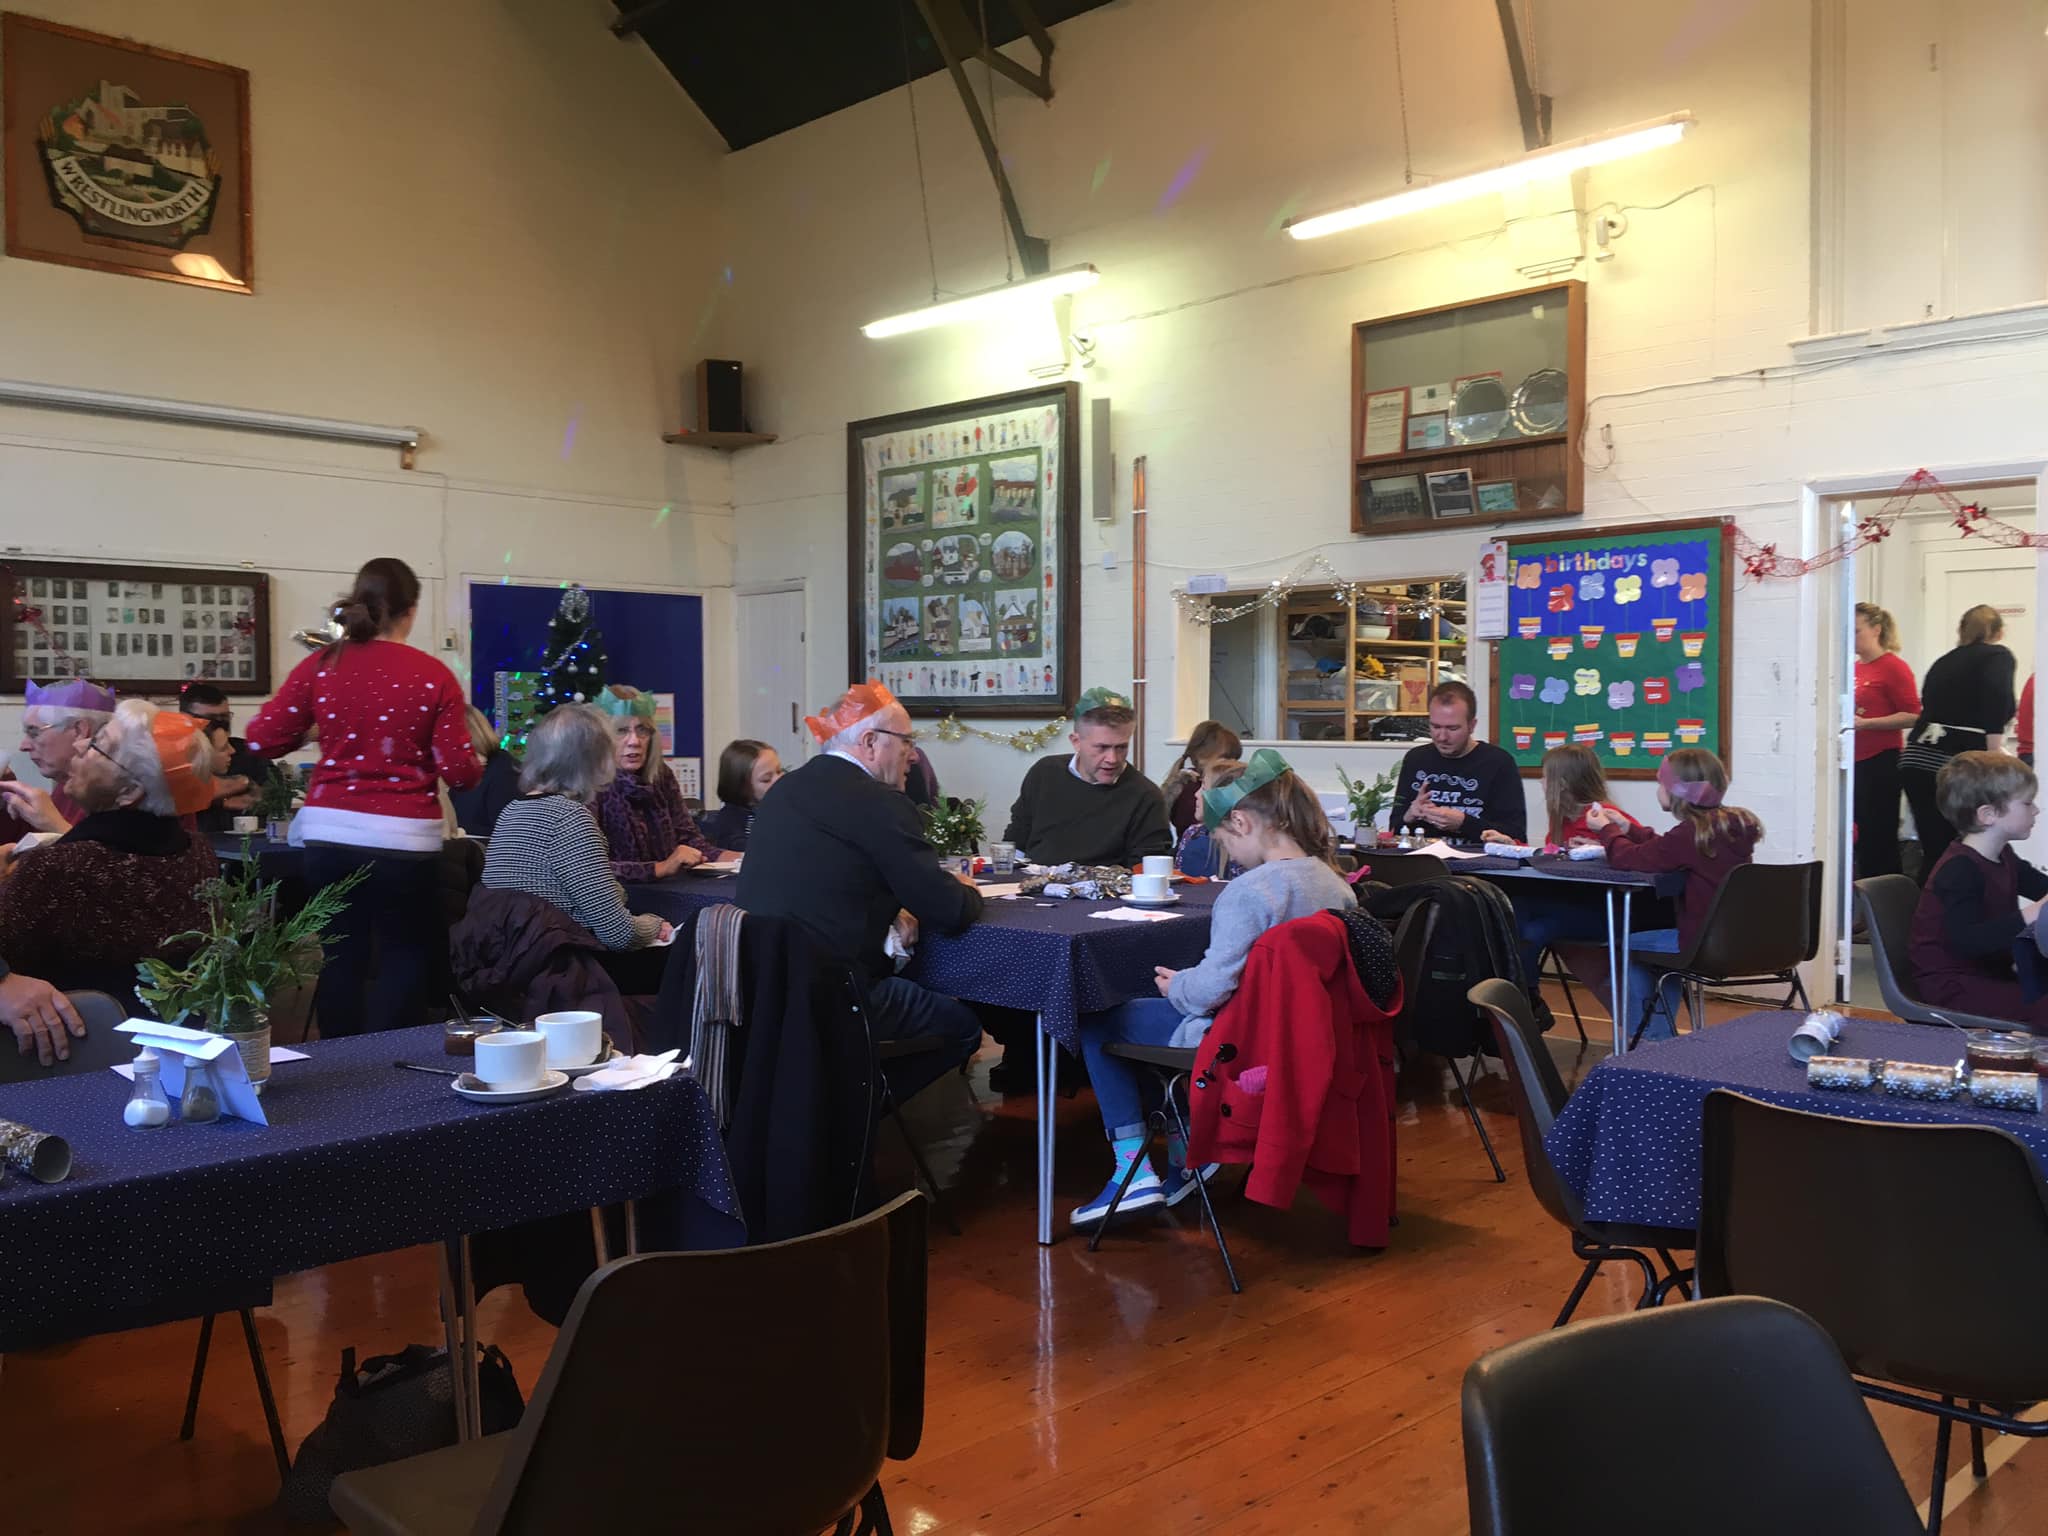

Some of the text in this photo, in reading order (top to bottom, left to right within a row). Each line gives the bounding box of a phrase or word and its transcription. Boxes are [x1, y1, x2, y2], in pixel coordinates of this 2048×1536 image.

[61, 161, 203, 222] WRESTLINGWORTH
[1544, 551, 1648, 573] birthdays
[1429, 790, 1462, 803] EAT
